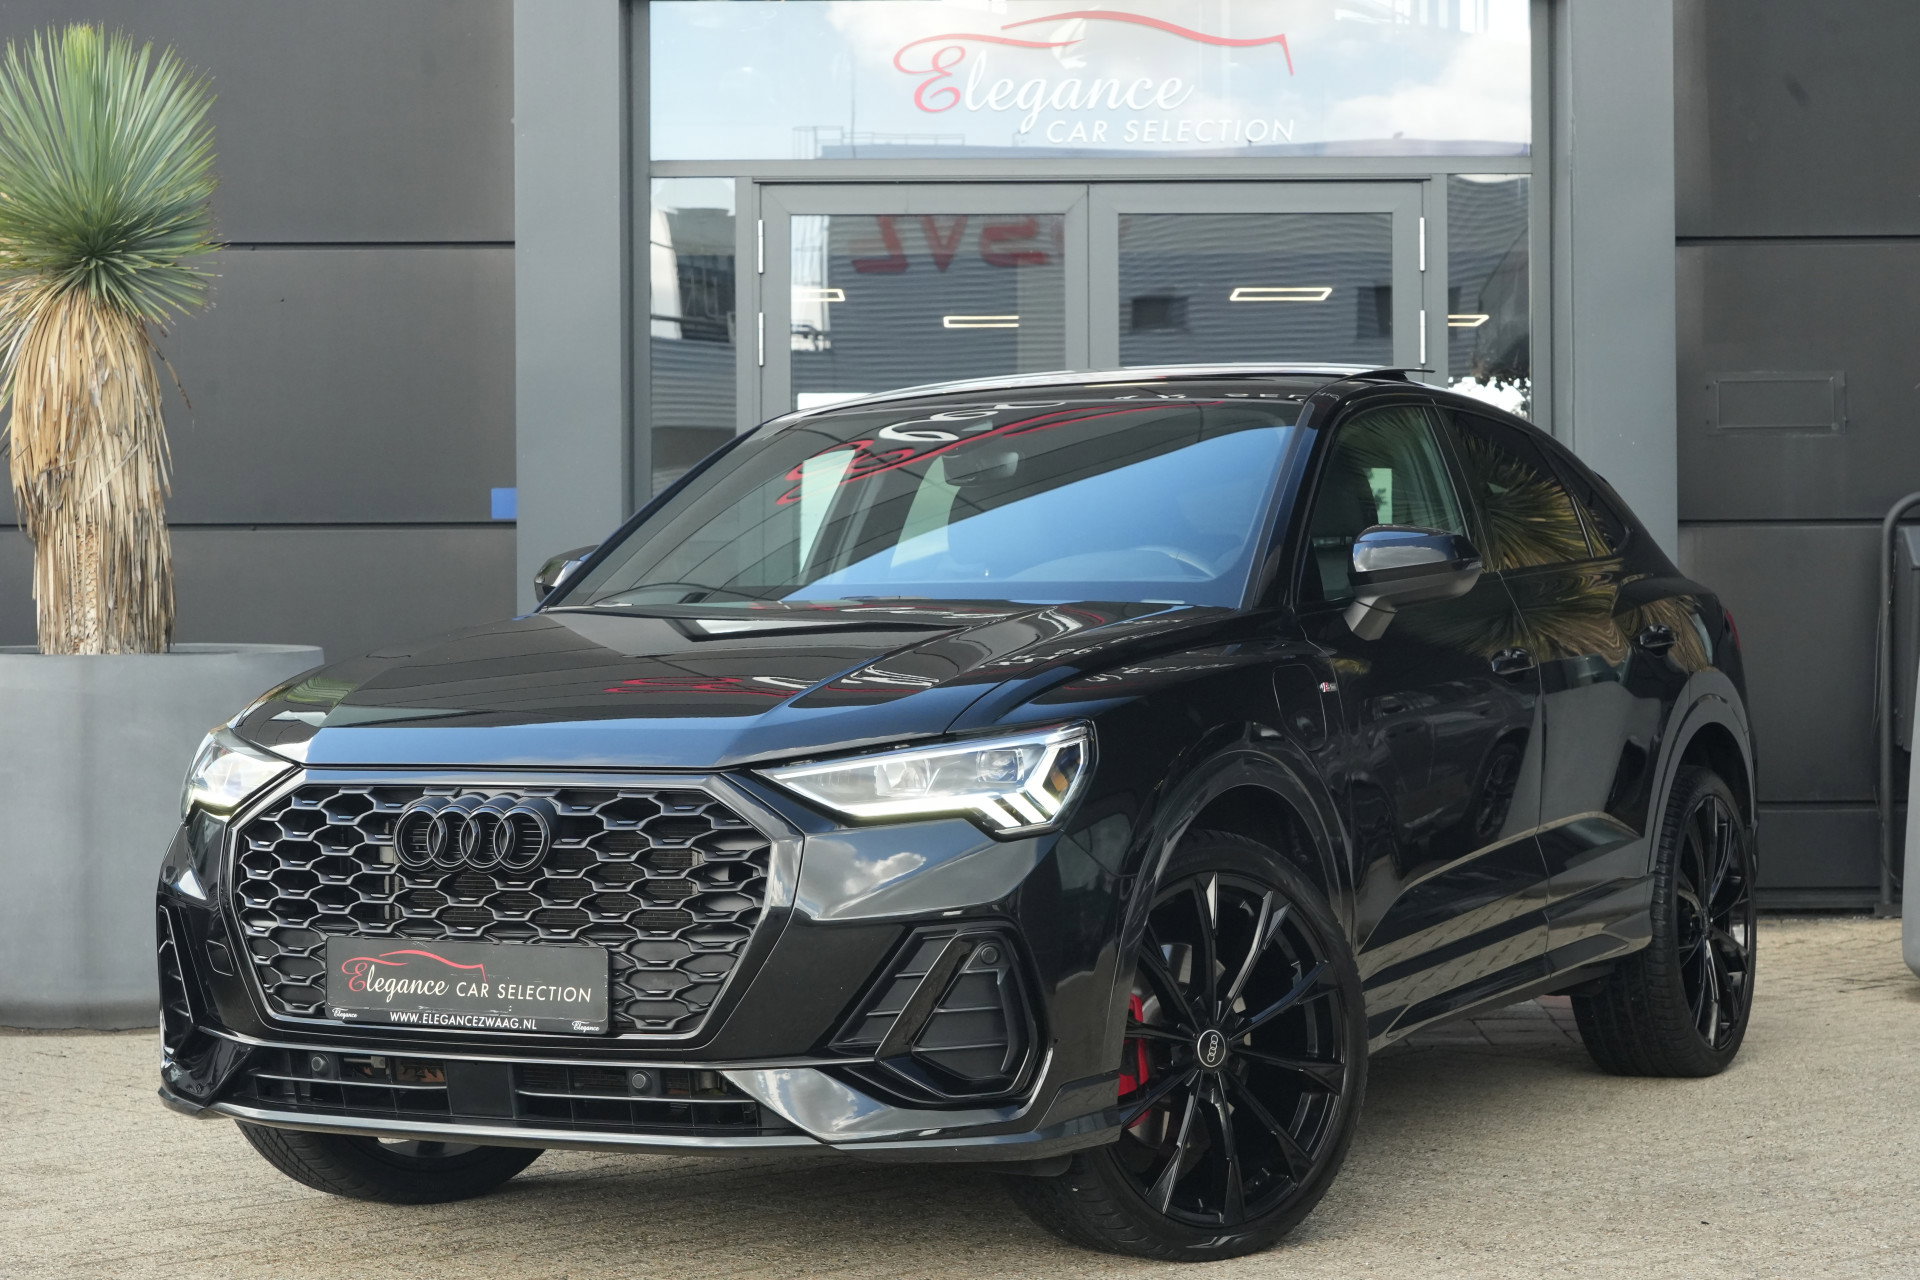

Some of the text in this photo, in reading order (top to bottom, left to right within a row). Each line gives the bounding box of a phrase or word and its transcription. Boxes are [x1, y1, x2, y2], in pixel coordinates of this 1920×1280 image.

[893, 34, 1195, 135] Elegance
[1046, 118, 1297, 144] CAR SELECTION
[341, 957, 592, 1003] Elegance CAR SELECTION
[332, 1008, 358, 1019] Elegance
[389, 1011, 538, 1030] WWW.ELEGANCEZWAAG.NL
[572, 1021, 600, 1033] Elegance
